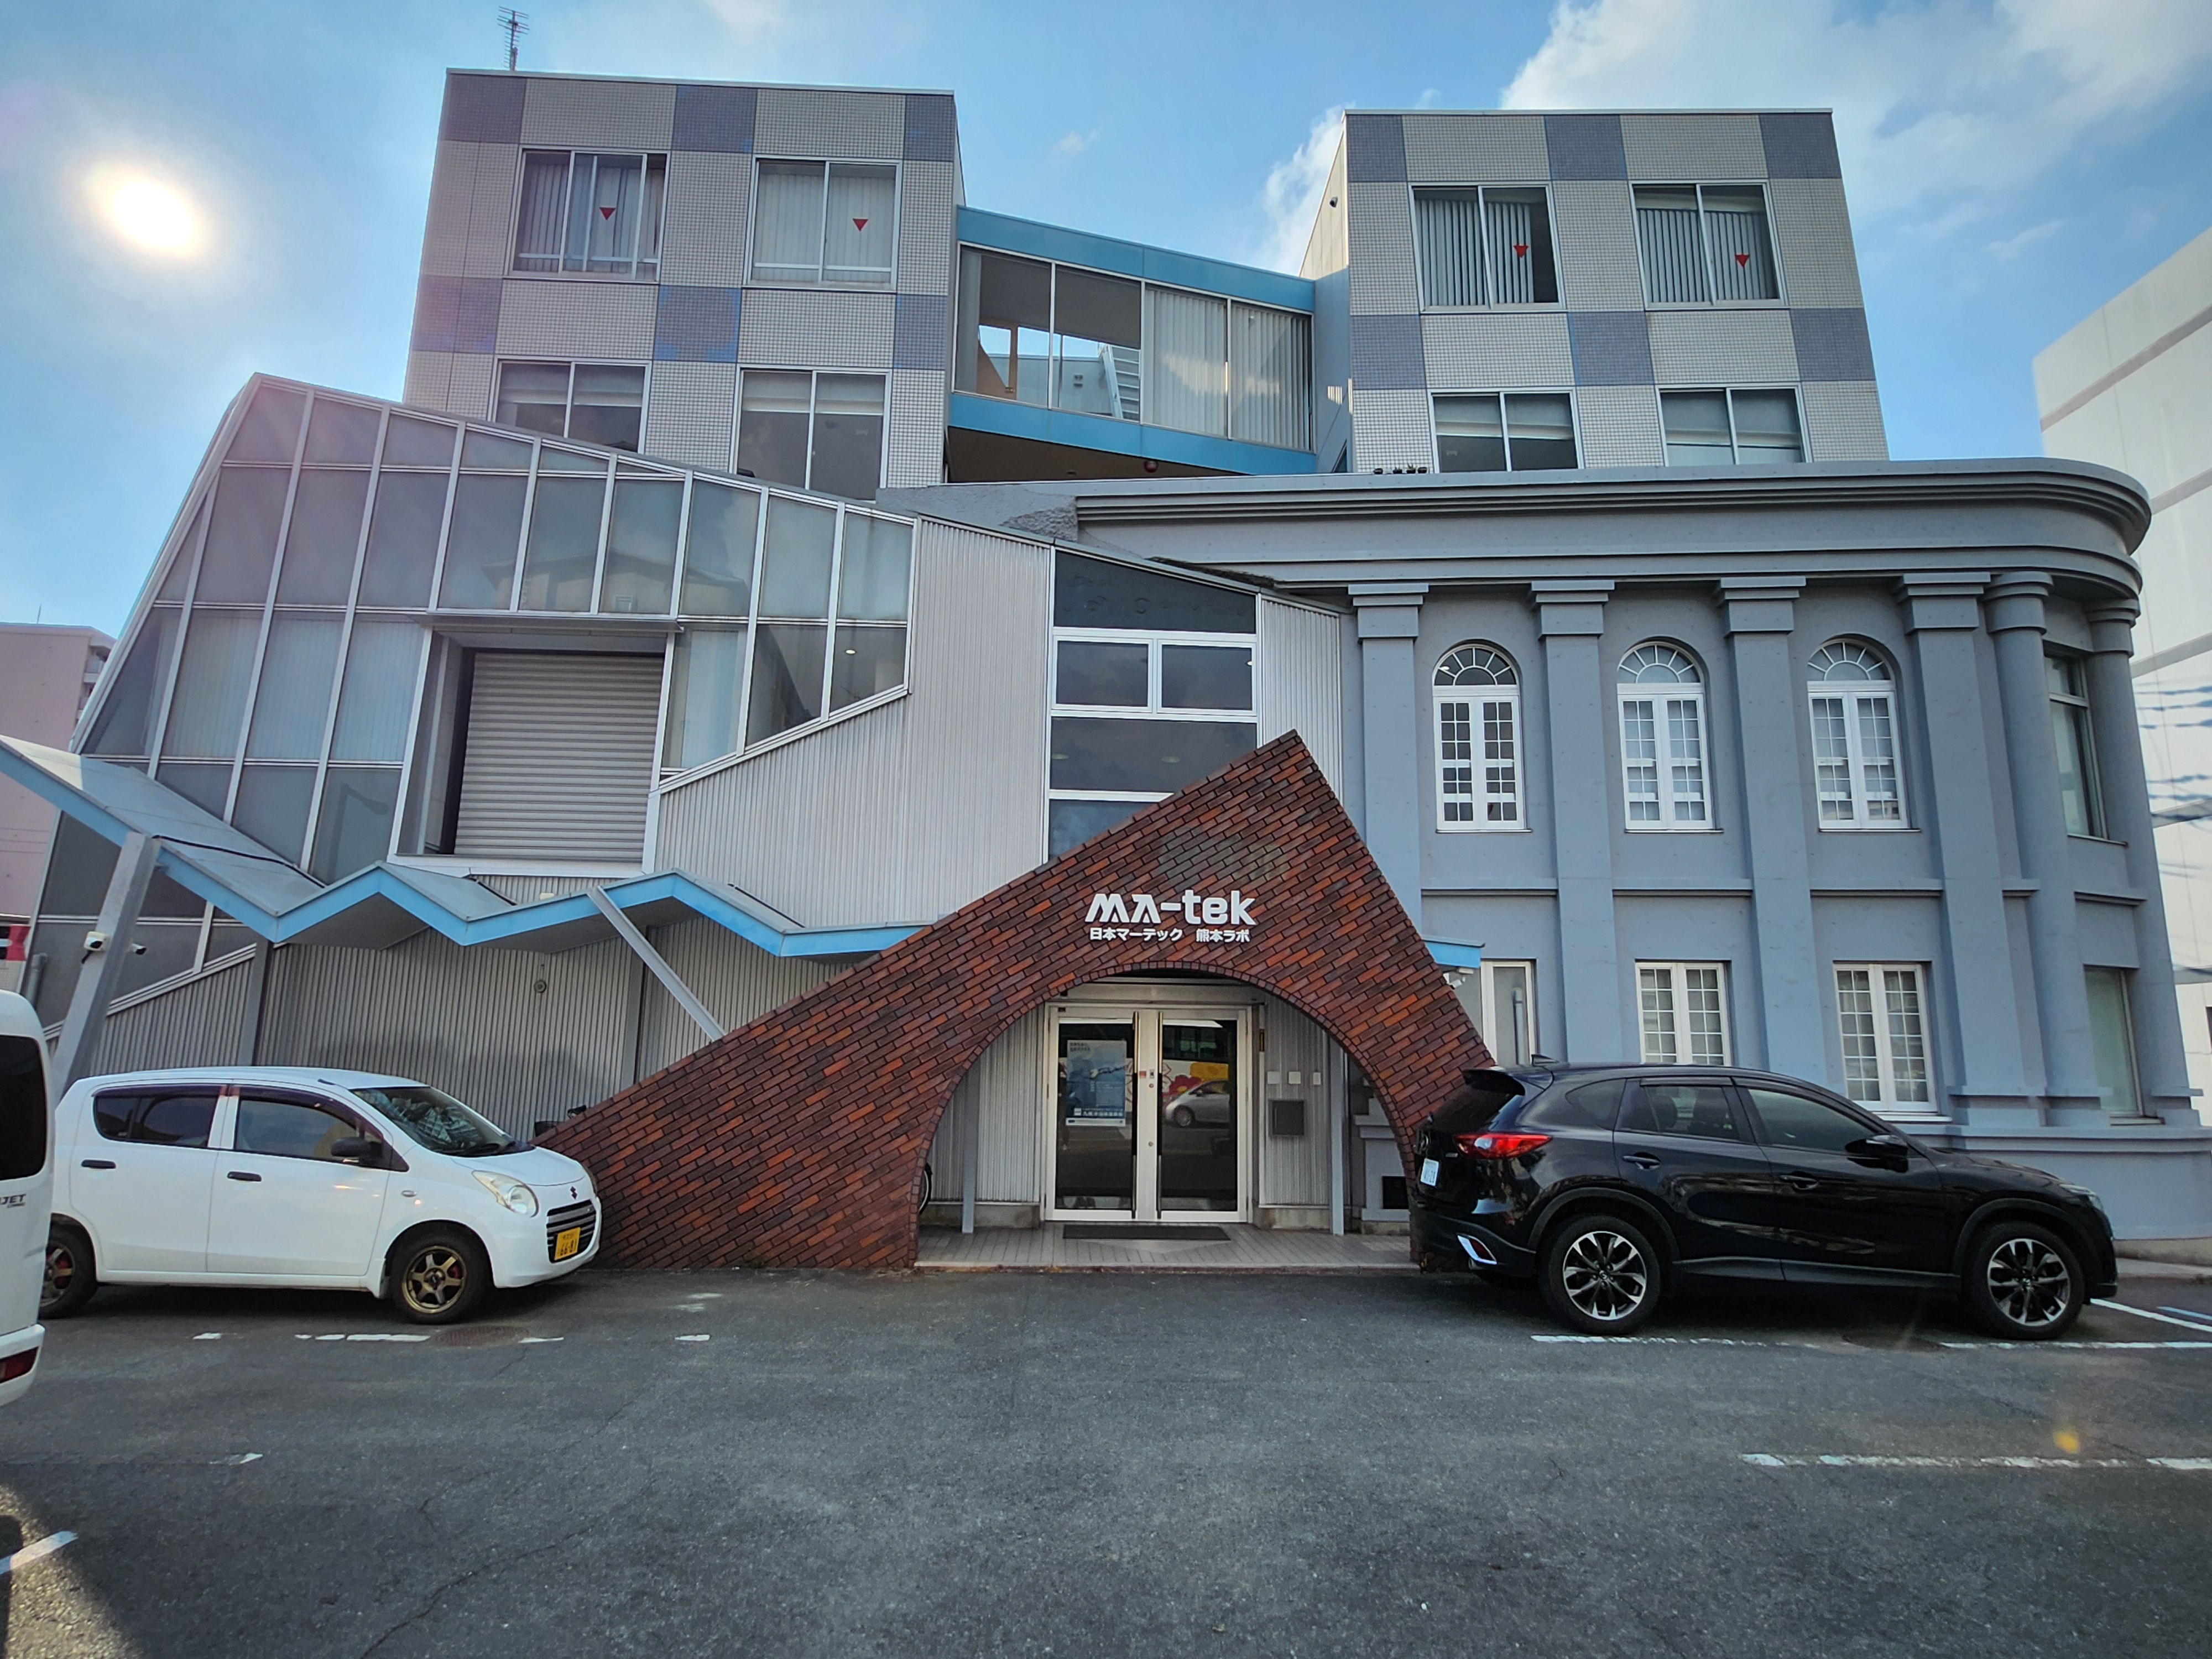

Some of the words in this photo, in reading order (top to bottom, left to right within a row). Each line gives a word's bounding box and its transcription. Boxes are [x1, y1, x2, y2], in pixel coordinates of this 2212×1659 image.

[1090, 927, 1183, 941] 日本マーテック
[1196, 928, 1250, 943] 熊本ラボ
